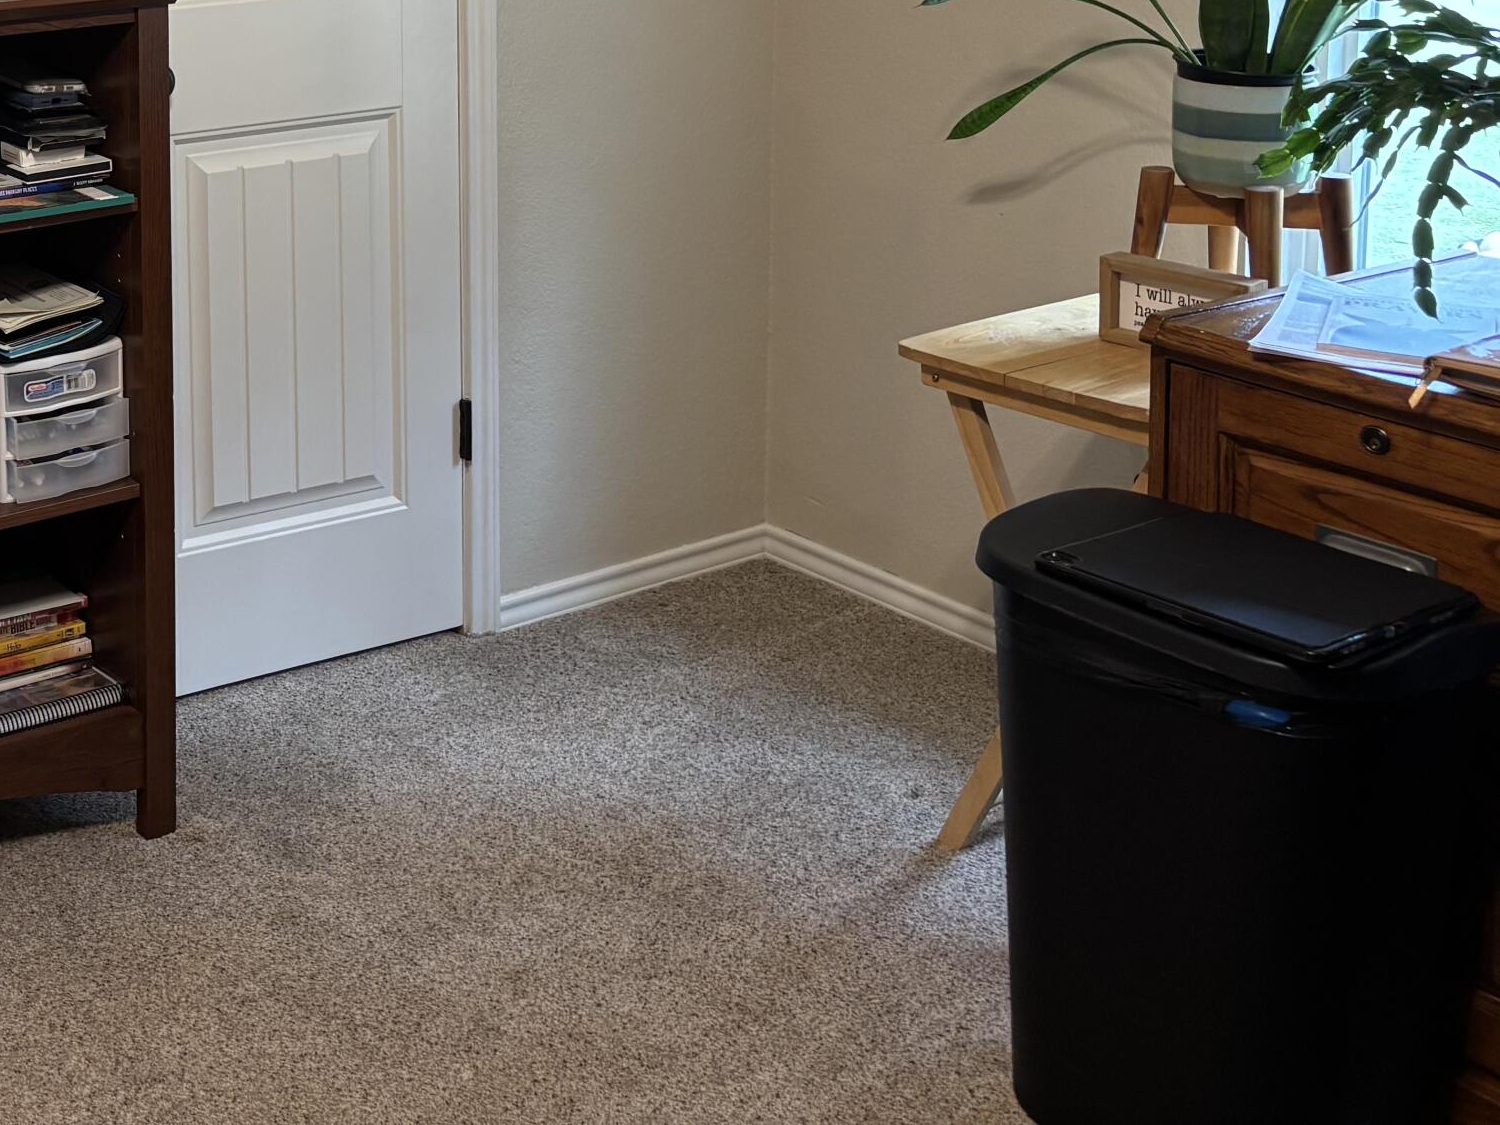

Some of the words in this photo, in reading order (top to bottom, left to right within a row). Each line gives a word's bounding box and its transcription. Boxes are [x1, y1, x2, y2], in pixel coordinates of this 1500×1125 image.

[1135, 283, 1141, 298] I
[1146, 288, 1172, 304] will
[10, 621, 35, 635] BIBLE
